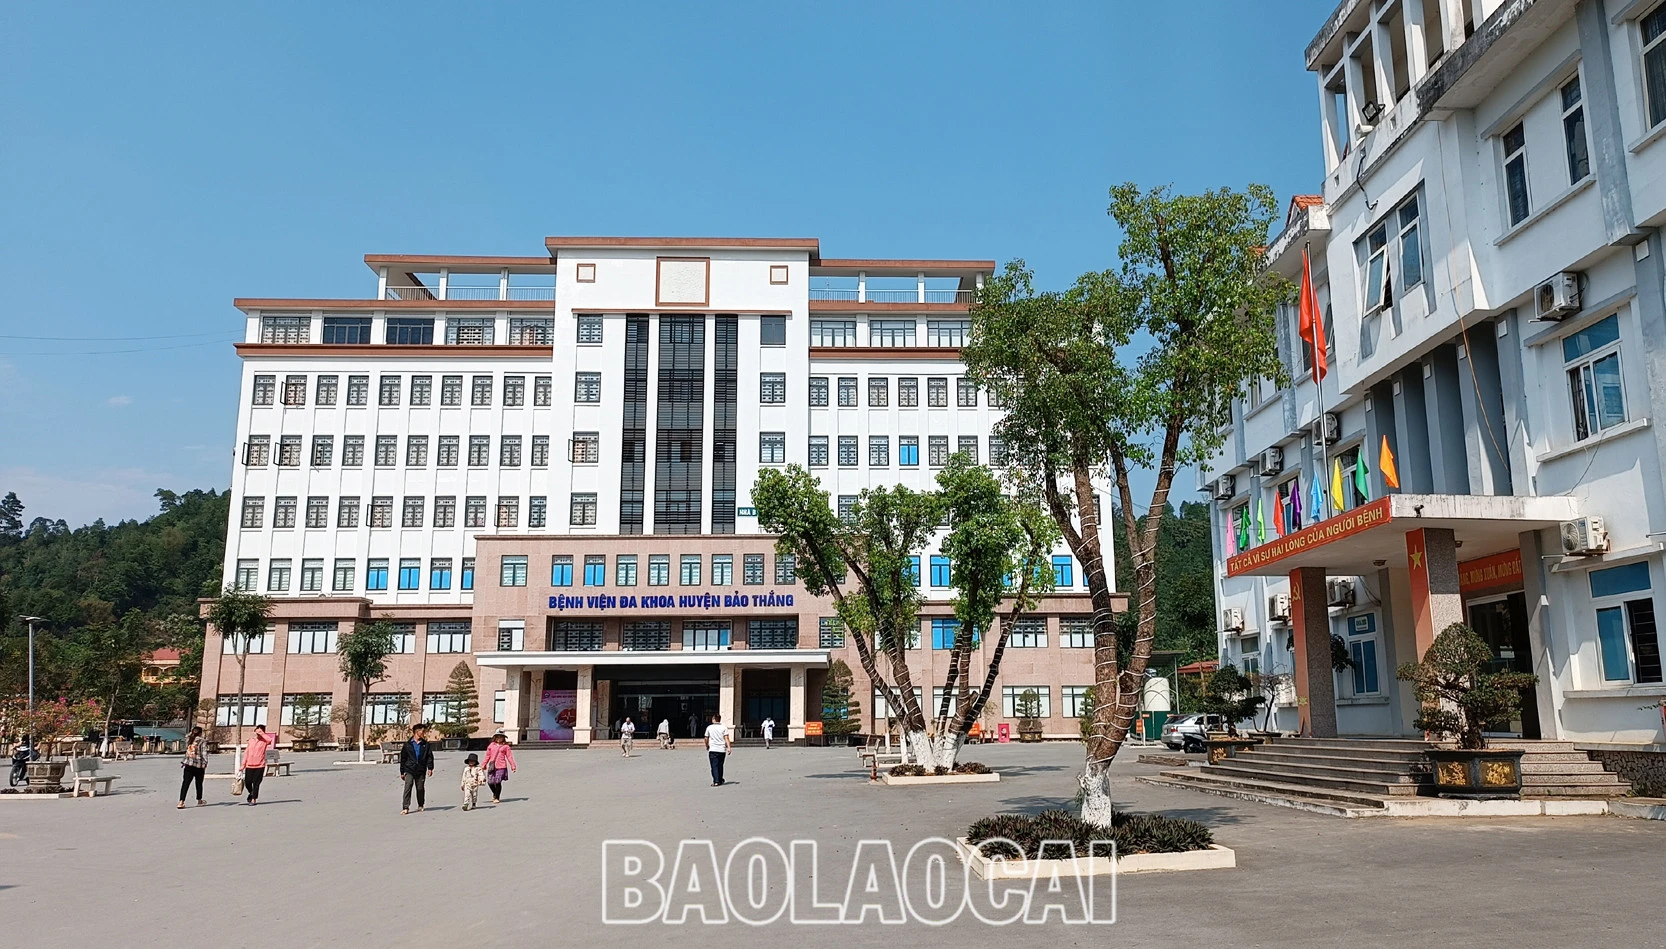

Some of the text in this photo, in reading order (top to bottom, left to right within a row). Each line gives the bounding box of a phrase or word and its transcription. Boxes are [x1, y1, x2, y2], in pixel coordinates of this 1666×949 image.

[1230, 507, 1383, 572] TẤT CẢ VÌ SỰ HÀI LÒNG CỦA NGƯỜI BỆNH
[548, 590, 794, 611] BỆNH VIỆN ĐA KHOA HUYỆN BẢO THẮNG
